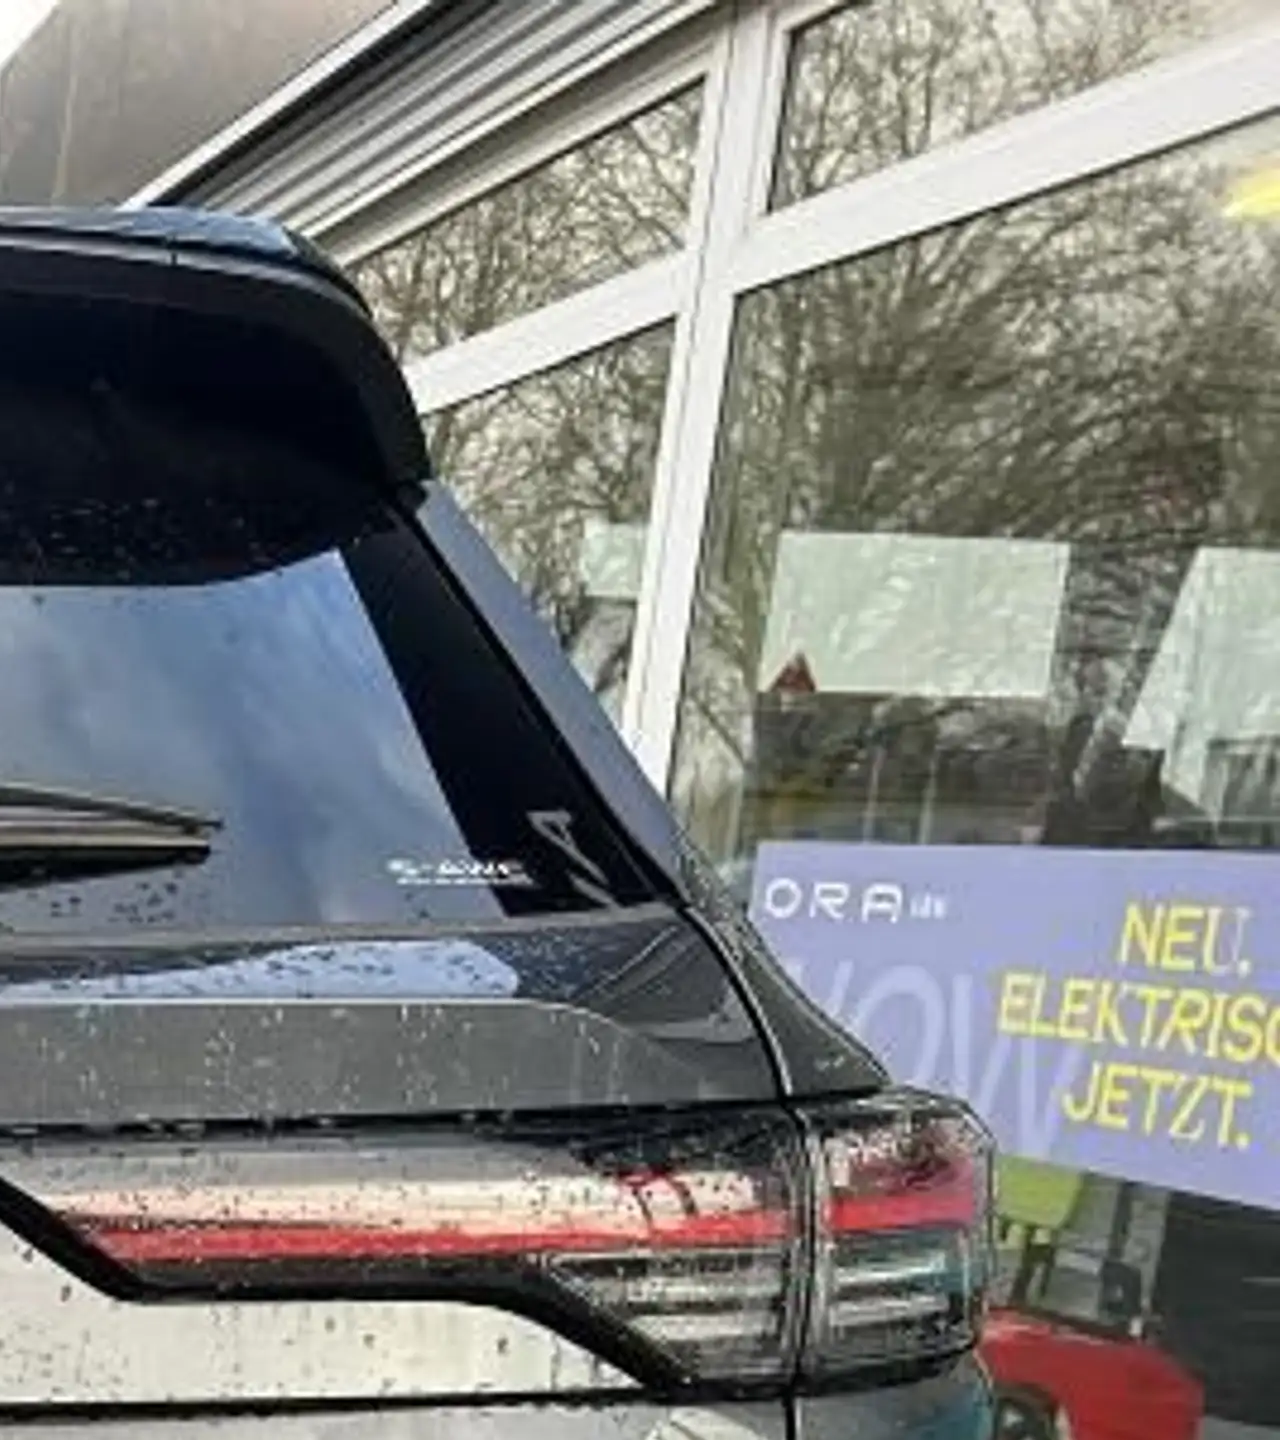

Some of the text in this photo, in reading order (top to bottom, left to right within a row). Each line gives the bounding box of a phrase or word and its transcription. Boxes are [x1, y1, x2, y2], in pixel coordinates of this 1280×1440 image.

[765, 878, 903, 924] ORA
[1119, 903, 1251, 976] NEU.
[1062, 1060, 1252, 1149] JETZT.
